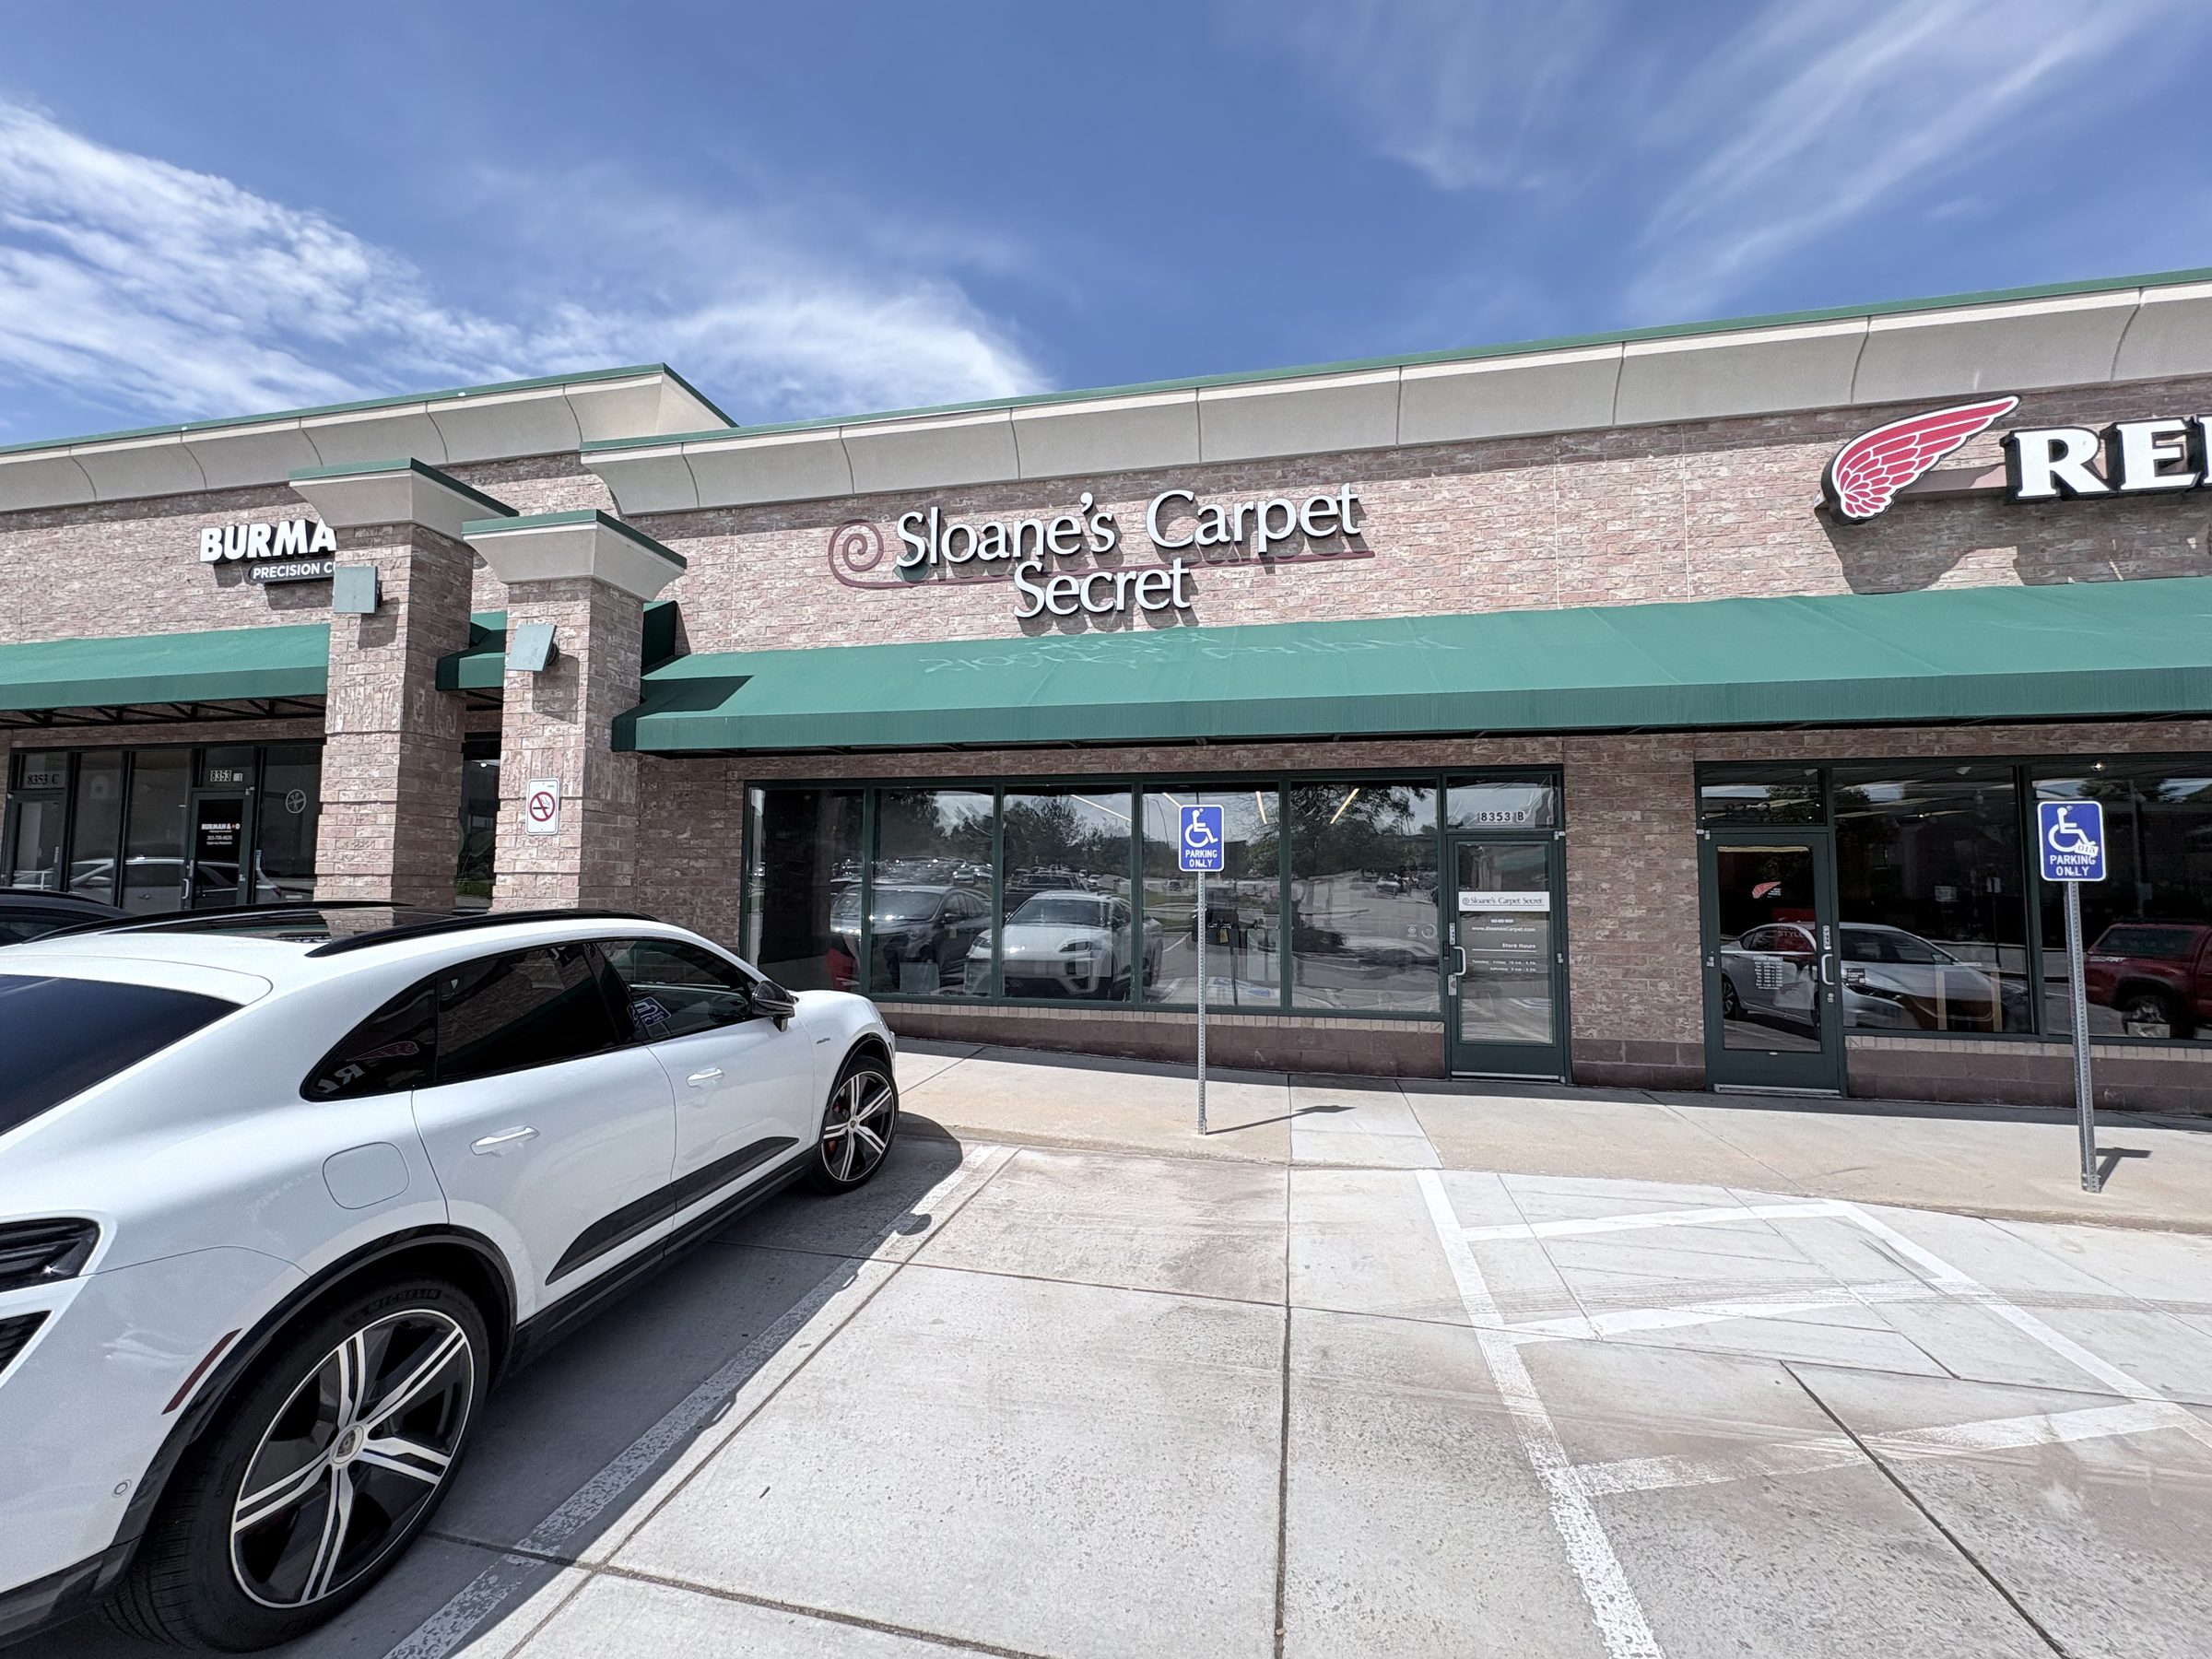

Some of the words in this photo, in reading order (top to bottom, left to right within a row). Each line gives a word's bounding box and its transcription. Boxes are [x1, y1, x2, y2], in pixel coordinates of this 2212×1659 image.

[2014, 415, 2212, 499] RE
[895, 491, 1115, 569] Sloane's
[1146, 483, 1361, 553] Carpet
[200, 518, 336, 561] BURMA
[253, 564, 320, 580] PRECISION
[1013, 557, 1190, 618] Secret
[28, 774, 48, 785] 8353
[52, 774, 60, 784] C
[211, 770, 231, 782] 8353
[1480, 812, 1511, 822] 8353
[1517, 811, 1524, 821] B
[1184, 849, 1218, 859] PARKING
[2050, 854, 2097, 865] PARKING
[1189, 859, 1213, 868] ONLY
[2055, 865, 2089, 877] ONLY
[1498, 897, 1521, 906] Carpet
